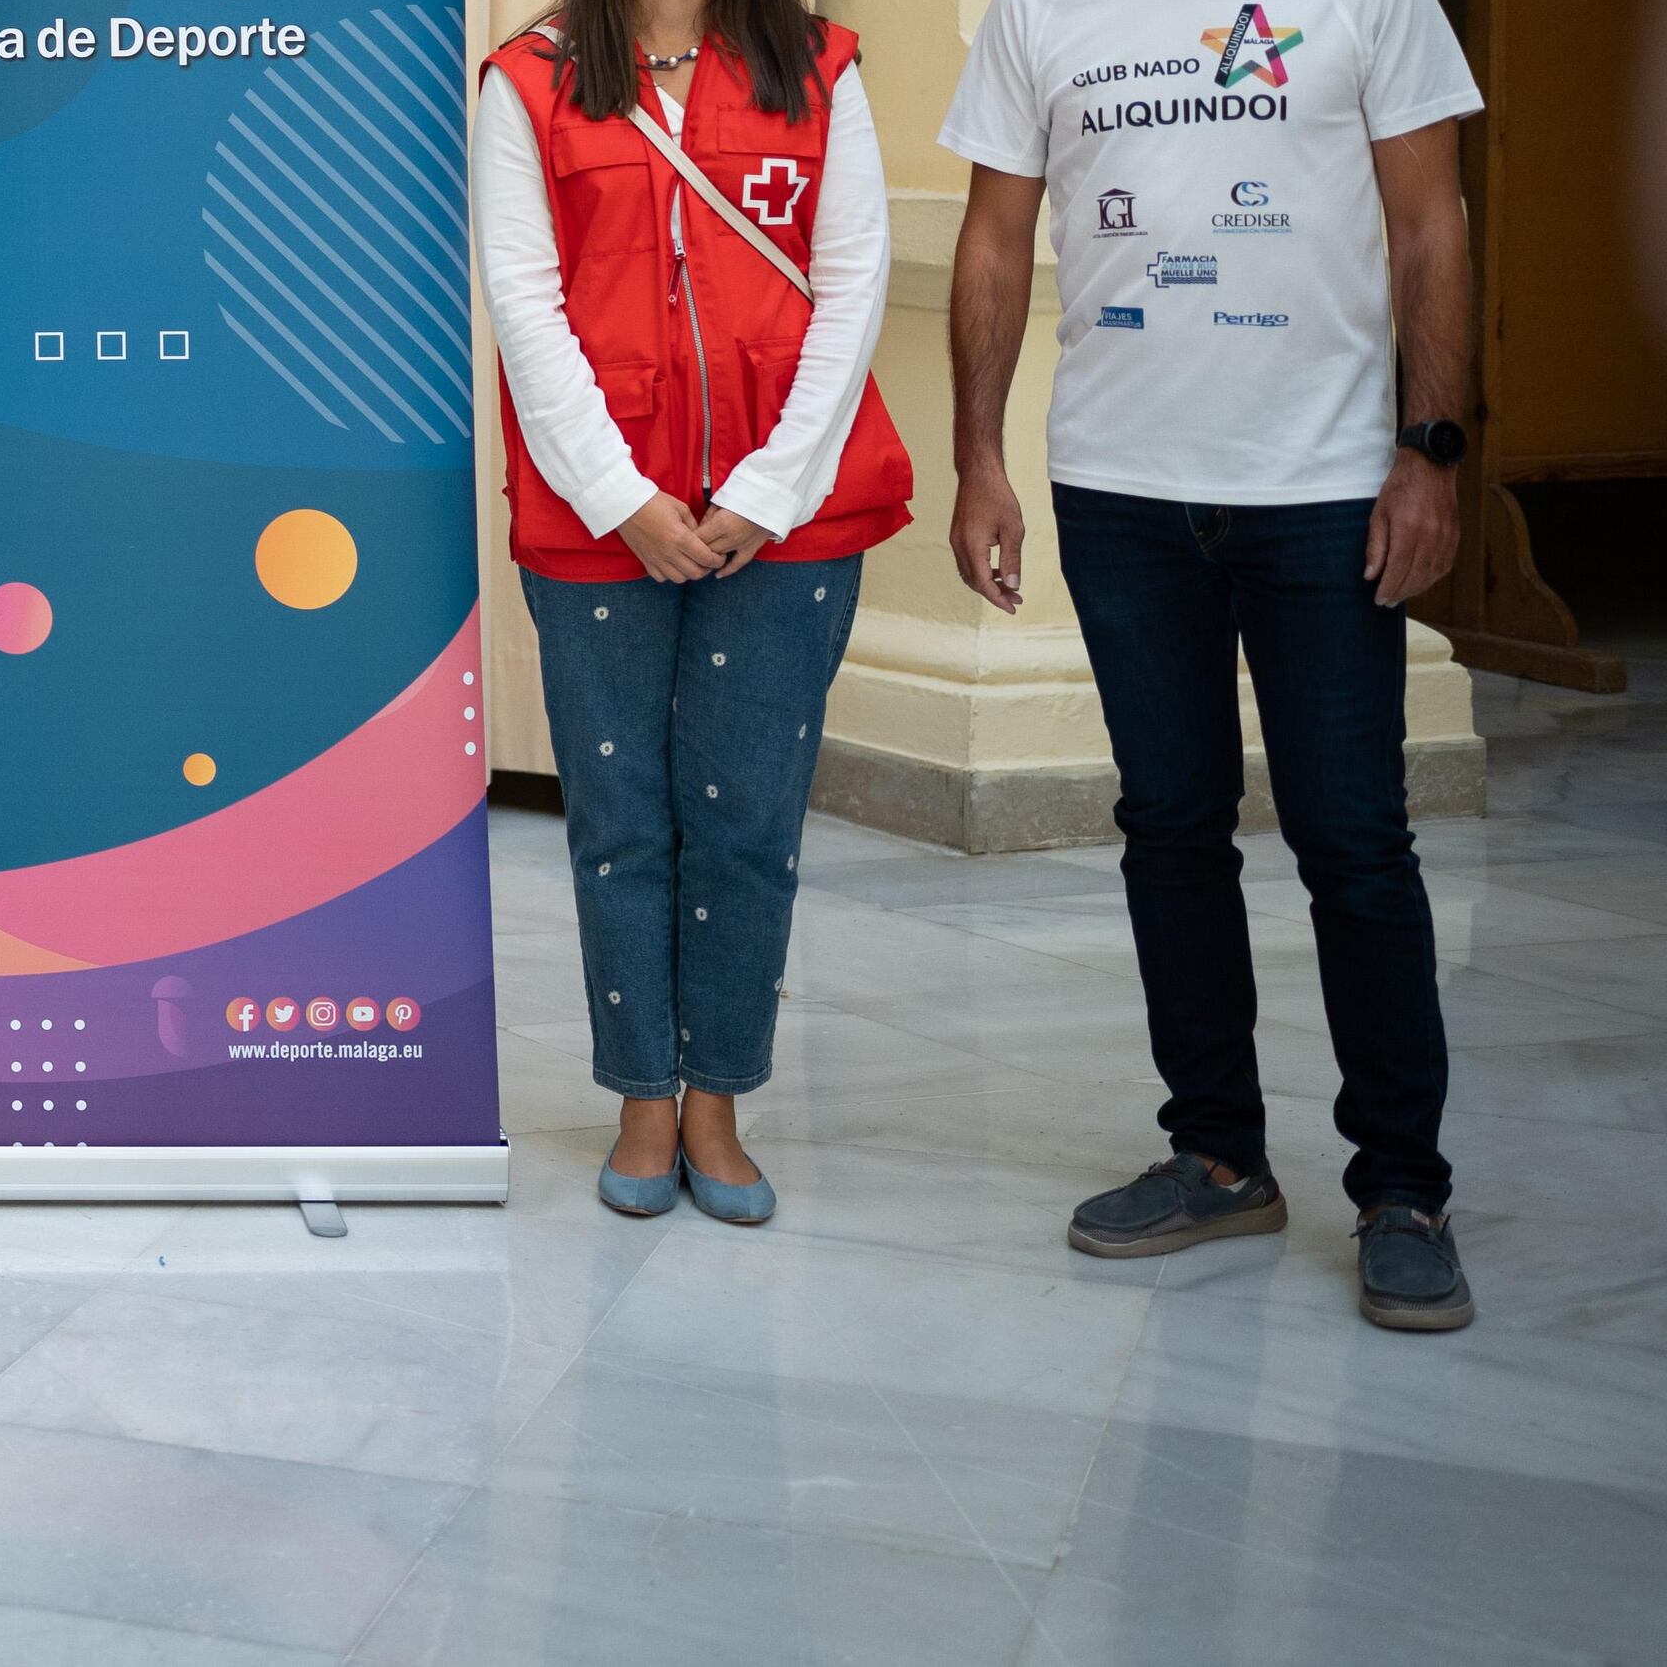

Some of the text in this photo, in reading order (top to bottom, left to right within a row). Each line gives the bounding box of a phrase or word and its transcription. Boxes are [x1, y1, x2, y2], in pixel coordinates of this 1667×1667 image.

[37, 18, 95, 58] de
[110, 17, 306, 65] Deporte
[1220, 12, 1250, 75] ALIQUINDOI
[1072, 58, 1201, 88] CLUB NADO
[1082, 95, 1287, 136] ALIQUINDOI
[1211, 214, 1291, 228] CREDISER
[1162, 255, 1217, 263] FARMACIA
[1214, 312, 1289, 328] Perrigo
[228, 1040, 423, 1062] www.deporte.malaga.eu
